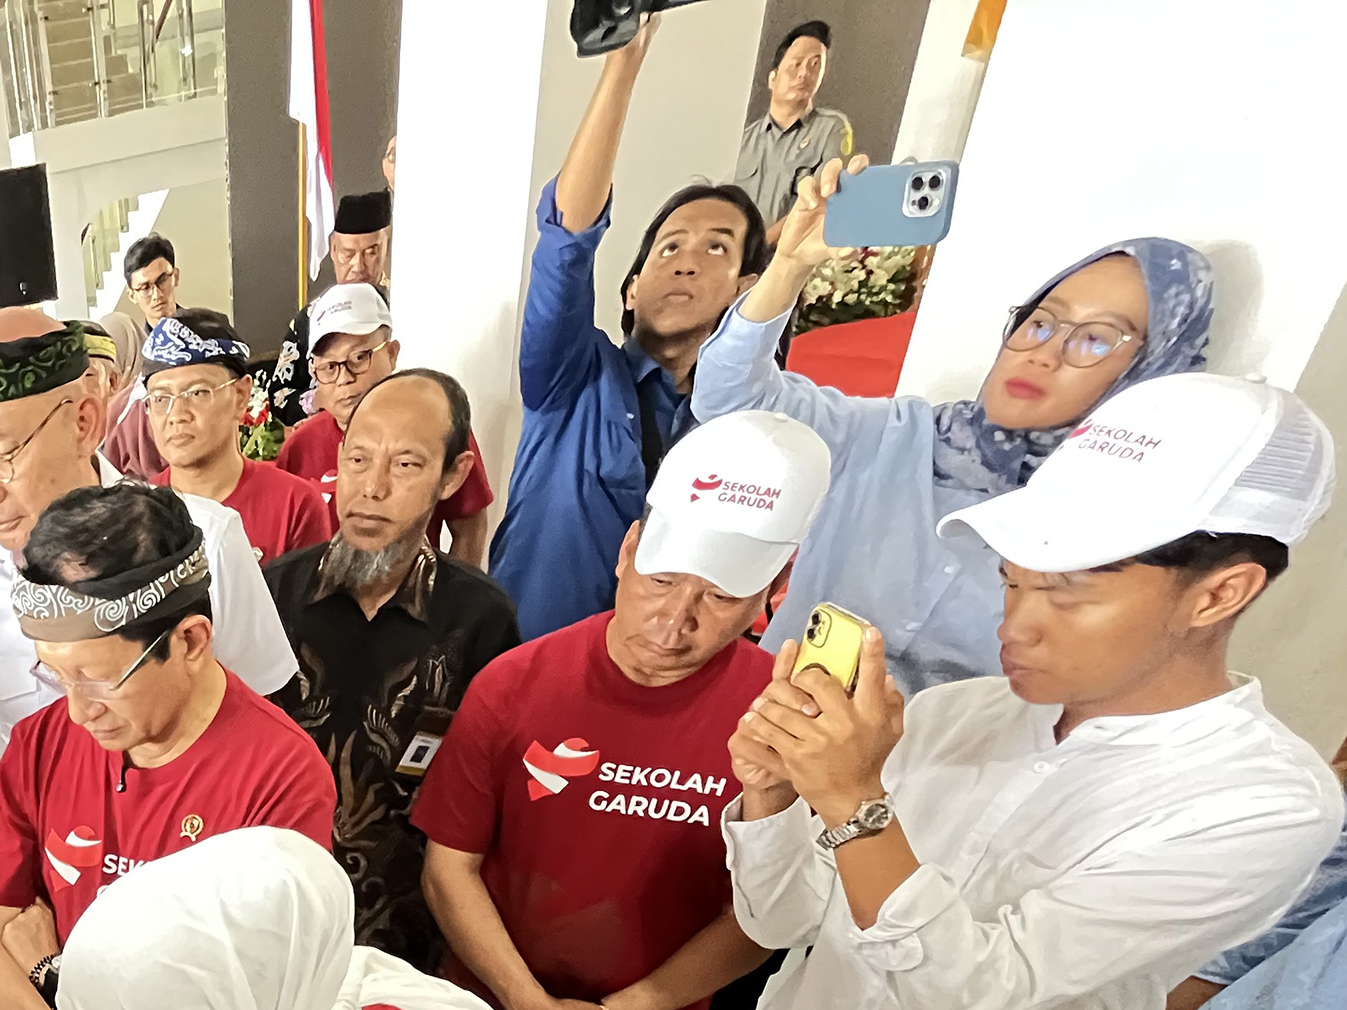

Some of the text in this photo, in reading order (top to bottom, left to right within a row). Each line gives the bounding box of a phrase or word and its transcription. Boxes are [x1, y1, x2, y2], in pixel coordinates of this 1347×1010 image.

[1088, 424, 1162, 450] SEKOLAH
[1078, 438, 1145, 463] GARUDA
[717, 492, 774, 512] GARUDA
[722, 481, 782, 500] SEKOLAH
[598, 762, 728, 797] SEKOLAH
[588, 790, 710, 827] GARUDA
